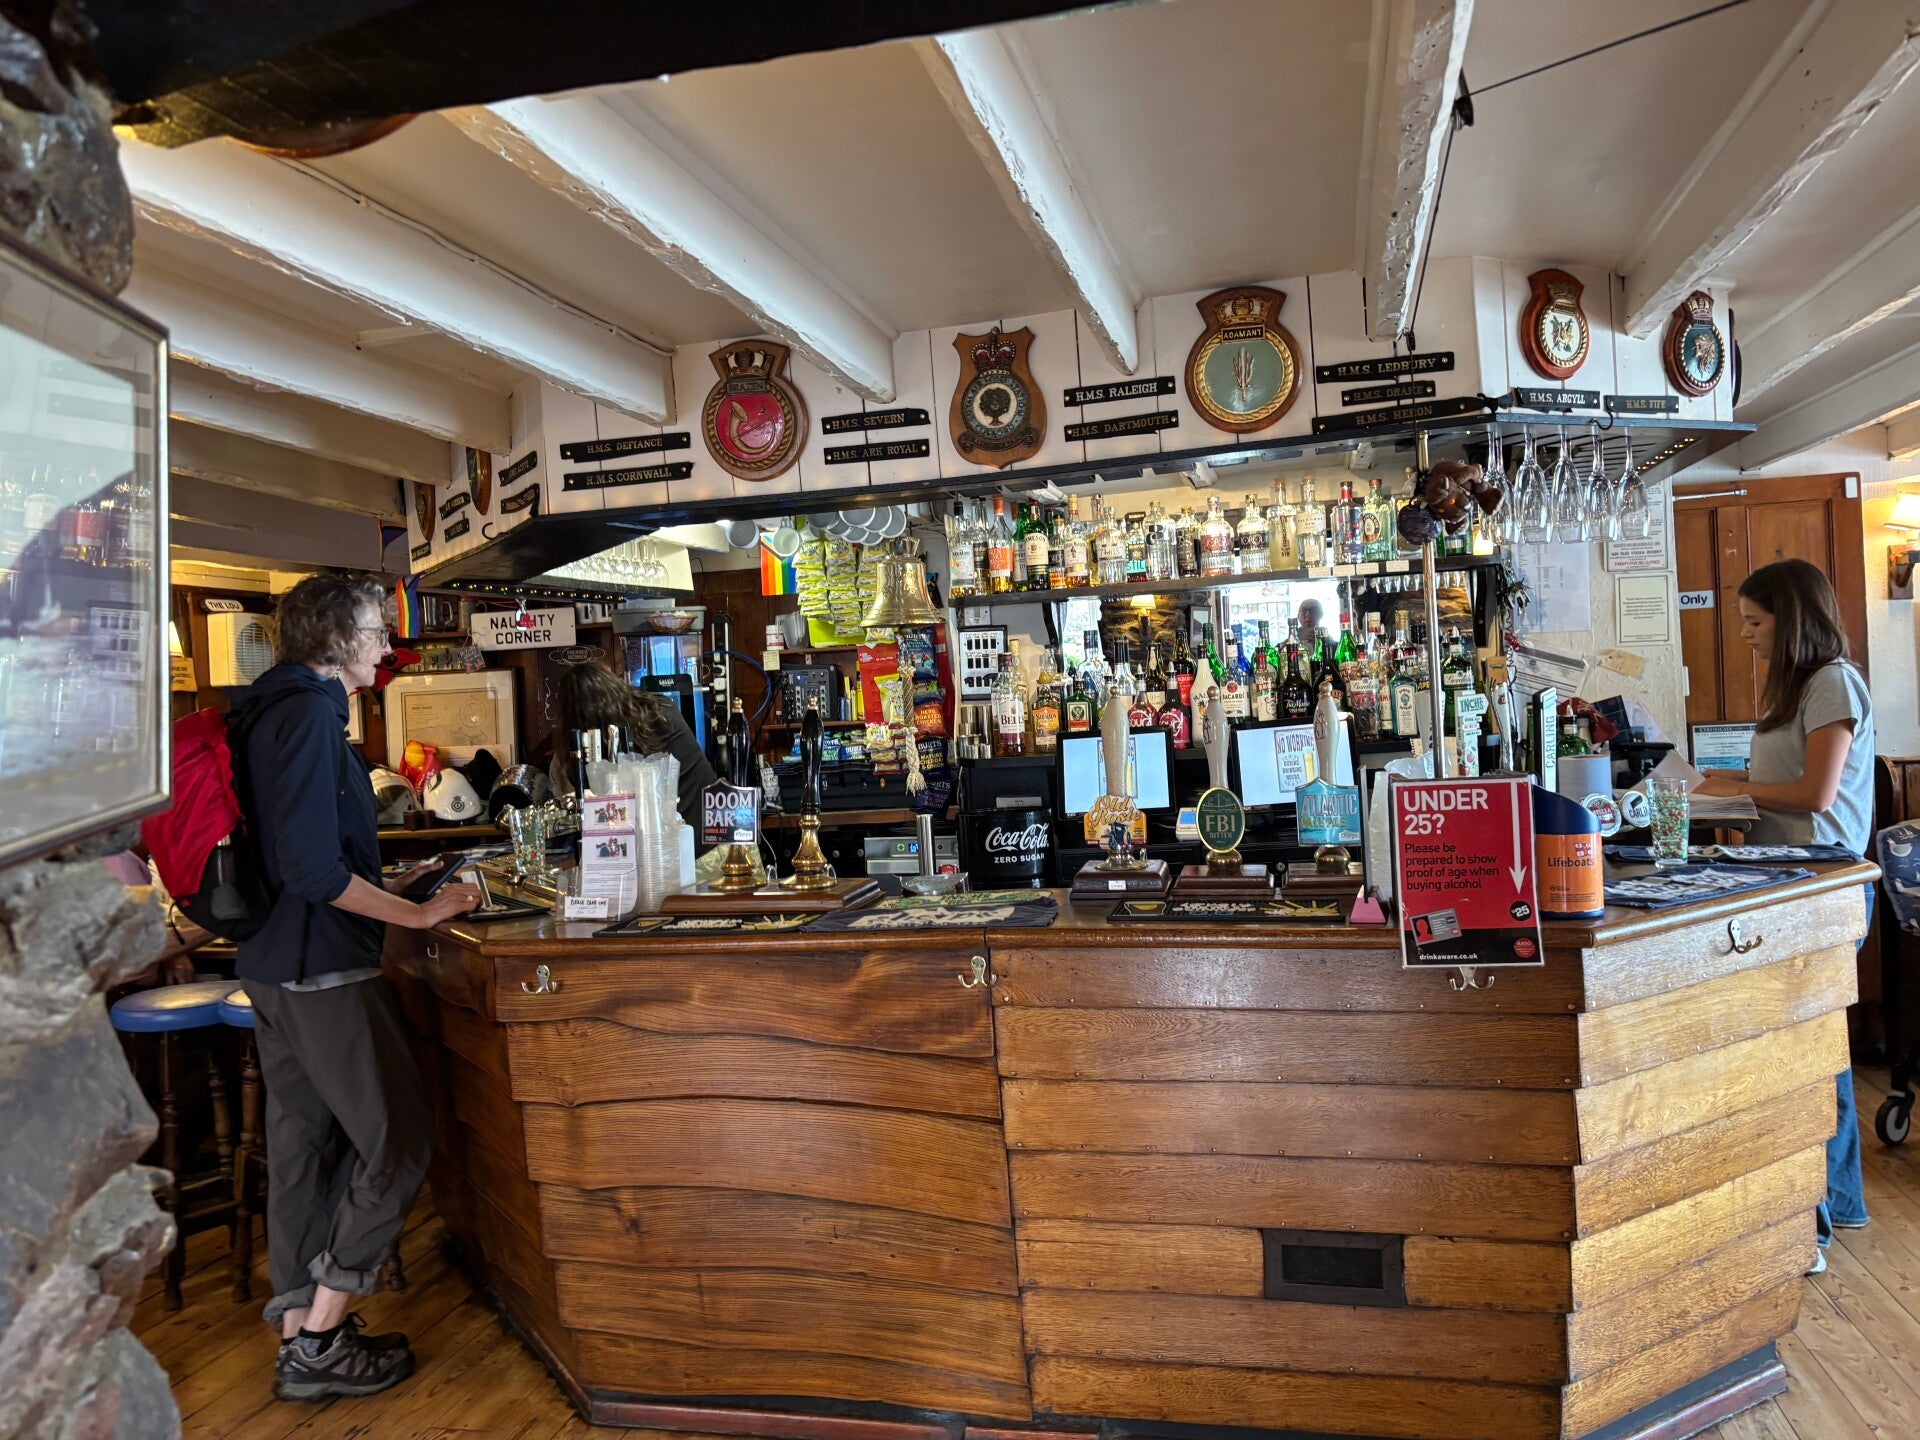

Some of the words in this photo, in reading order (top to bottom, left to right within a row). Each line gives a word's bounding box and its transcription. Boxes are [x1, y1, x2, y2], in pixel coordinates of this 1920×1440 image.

[1223, 330, 1262, 340] ADAMANT
[1378, 358, 1437, 374] LEDBURY
[1076, 390, 1106, 402] H.M.S.
[1109, 382, 1158, 398] RALEIGH
[1386, 386, 1424, 397] DRAKE
[1556, 393, 1586, 405] ARGYLL
[1649, 399, 1666, 409] FIFE
[1393, 406, 1433, 420] HERON
[832, 418, 861, 430] H.M.S.
[863, 413, 906, 426] SEVERN
[1072, 425, 1101, 437] H.M.S.
[1104, 415, 1170, 433] DARTMOUTH
[615, 438, 664, 451] DEFIANCE
[833, 449, 859, 461] H.M.S.
[862, 447, 884, 458] ARK
[887, 444, 918, 455] ROYAL
[586, 475, 616, 486] H.M.S.
[616, 467, 672, 482] CORNWALL
[208, 601, 224, 610] THE
[1681, 594, 1708, 606] Only
[490, 613, 555, 630] NAUTY
[496, 630, 552, 645] CORNER
[1546, 714, 1556, 768] CARLING
[705, 791, 753, 810] DOOM
[1094, 795, 1131, 813] Old
[1301, 793, 1358, 817] ATLANTIC
[1403, 788, 1489, 812] UNDER
[705, 810, 736, 828] BAR
[1088, 807, 1142, 828] Rosie
[1205, 814, 1236, 833] FBI
[1301, 817, 1324, 828] PALE
[1404, 813, 1445, 835] 25?
[985, 823, 1050, 852] Coca-Cola
[1209, 832, 1233, 840] BITTER
[1405, 843, 1440, 853] Please
[1443, 842, 1456, 853] be
[994, 856, 1018, 864] ZERO
[1020, 853, 1046, 862] SUGAR
[1406, 855, 1453, 868] prepared
[1456, 855, 1466, 864] to
[1468, 854, 1498, 865] show
[1547, 857, 1595, 867] Lifeboats
[1407, 867, 1434, 880] proof
[1435, 867, 1446, 877] of
[1448, 869, 1467, 879] age
[1470, 866, 1500, 876] when
[1407, 879, 1442, 893] buying
[1444, 878, 1483, 889] alcohol
[1418, 952, 1478, 961] drinkaware.co.uk
